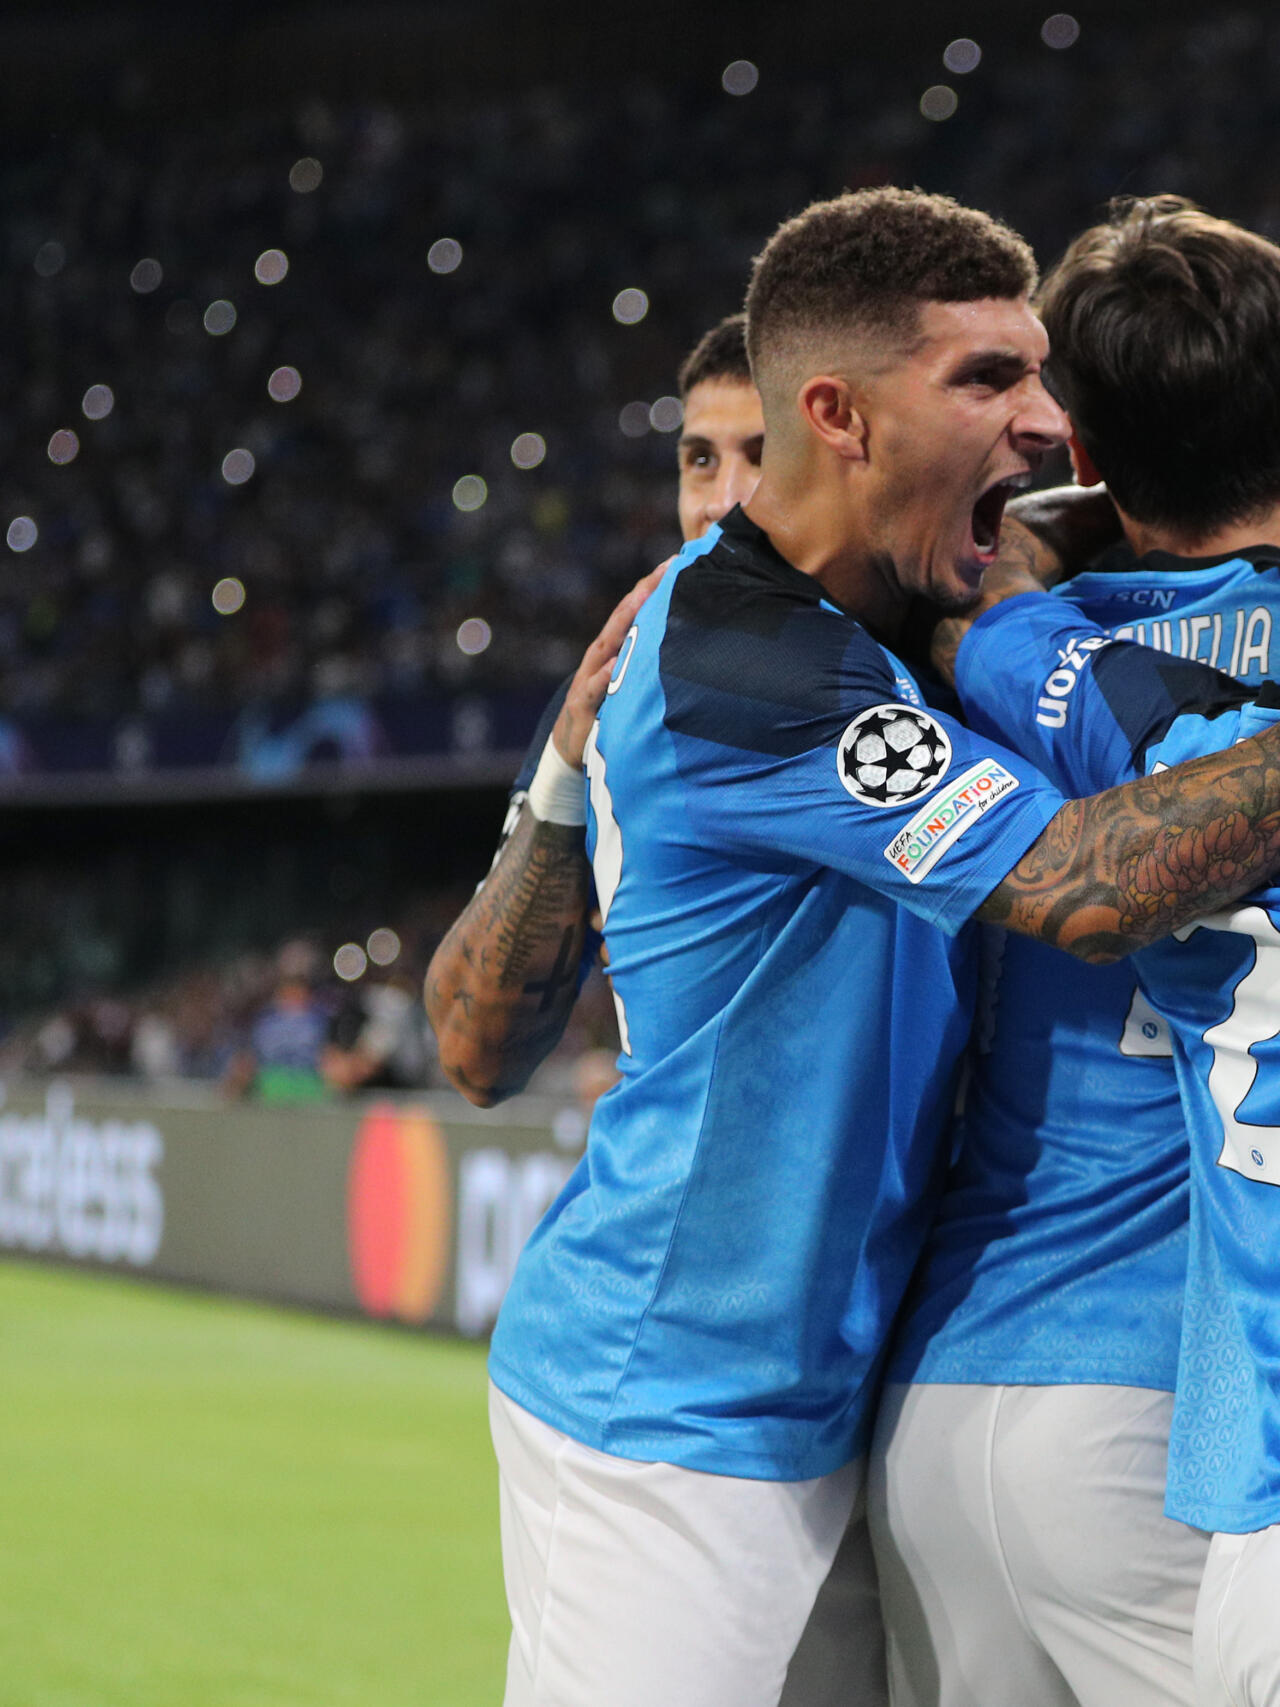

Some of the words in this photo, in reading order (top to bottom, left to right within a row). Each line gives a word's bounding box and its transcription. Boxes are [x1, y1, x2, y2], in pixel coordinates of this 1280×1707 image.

[978, 799, 988, 812] for
[989, 780, 1014, 800] children
[896, 770, 1006, 871] FOUNDATION
[889, 830, 914, 860] UEFA
